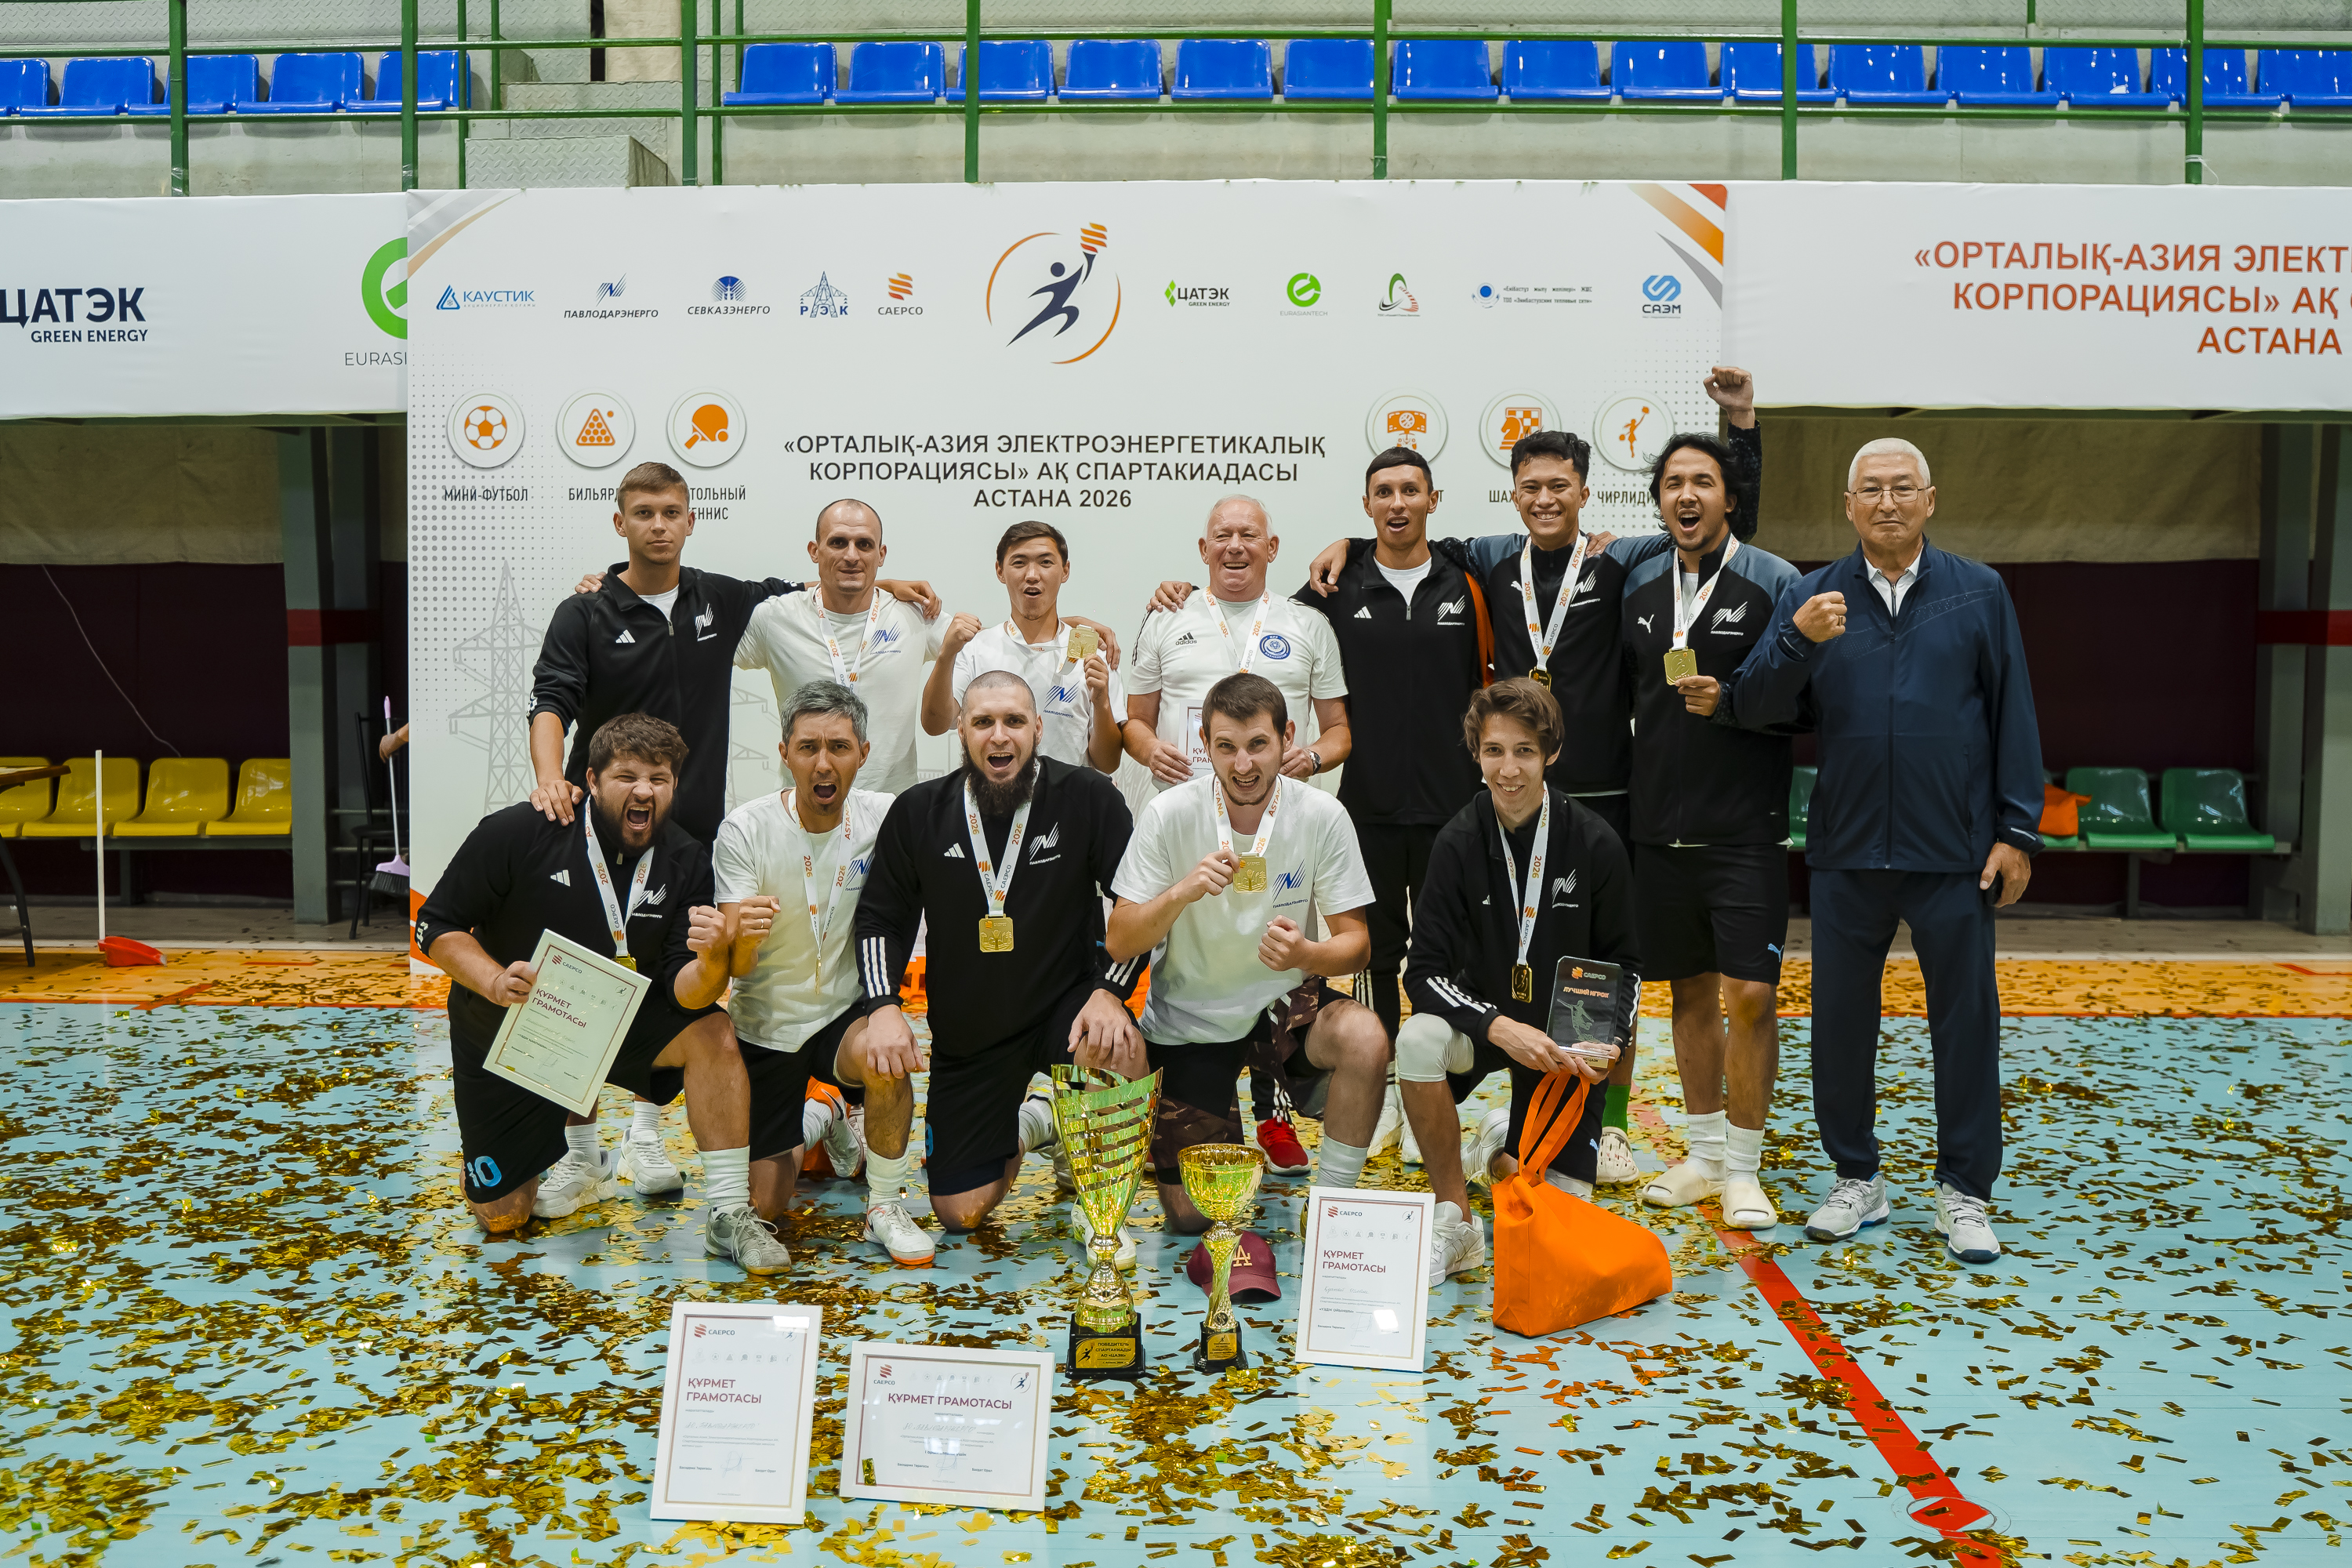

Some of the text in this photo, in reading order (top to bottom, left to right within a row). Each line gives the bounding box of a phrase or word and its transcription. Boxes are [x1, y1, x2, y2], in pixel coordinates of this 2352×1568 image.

[1915, 241, 2352, 276] «ОРТАЛЫҚ-АЗИЯ ЭЛЕКТ
[463, 290, 535, 302] КАУСТИК
[1178, 287, 1230, 301] ЦАТЭК
[1953, 282, 2339, 320] КОРПОРАЦИЯСЫ» АҚ
[0, 287, 147, 329] ЦАТЭК
[564, 309, 659, 319] ПАВЛОДАРЭНЕРГО
[688, 306, 771, 314] СЕВКАЗЭНЕРГО
[878, 307, 924, 315] CAEPCO
[1642, 304, 1681, 314] САЭМ
[31, 329, 148, 343] GREEN ENERGY
[2198, 326, 2343, 355] АСТАНА
[345, 351, 408, 366] EURASI
[784, 434, 1325, 458] «ОРТАЛЫҚ-АЗИЯ ЭЛЕКТРОЭНЕРГЕТИКАЛЫҚ
[810, 461, 1298, 485] КОРПОРАЦИЯСЫ» АҚ СПАРТАКИАДАСЫ
[444, 488, 529, 502] МИНИ-ФУТБОЛ
[690, 485, 746, 500] ТОЛЬНЫЙ
[974, 488, 1132, 508] АСТАНА 2026
[1490, 490, 1514, 503] ШАХ
[1597, 490, 1653, 506] ЧИРЛИДИ
[689, 507, 728, 520] ЕННИС
[1571, 540, 1584, 569] ASTANA
[1524, 581, 1533, 601] 2026
[1559, 587, 1570, 607] 2026
[1699, 584, 1712, 601] 2026
[1252, 620, 1262, 637] 2026
[1548, 623, 1559, 645] CAEPCO
[828, 639, 839, 658] 2026
[969, 812, 980, 836] 2026
[1011, 822, 1023, 846] 2026
[596, 862, 608, 885] 2026
[637, 862, 647, 884] 2026
[804, 855, 813, 878] 2026
[1532, 855, 1542, 879] 2026
[836, 865, 847, 887] 2026
[1000, 864, 1011, 889] CAEPCO
[610, 904, 620, 928] CAEPCO
[562, 961, 583, 974] CAEPCO
[1583, 972, 1606, 981] CAEPCO
[536, 988, 572, 1009] ҚҰРМЕТ
[1563, 986, 1610, 999] ЛУЧШИЙ ИГРОК
[532, 996, 587, 1028] ГРАМОТАСЫ
[1323, 1250, 1364, 1260] ҚҰРМЕТ
[1323, 1261, 1386, 1273] ГРАМОТАСЫ
[688, 1377, 736, 1388] ҚҰРМЕТ
[686, 1392, 762, 1404] ГРАМОТАСЫ
[887, 1392, 1012, 1410] ҚҰРМЕТ ГРАМОТАСЫ
